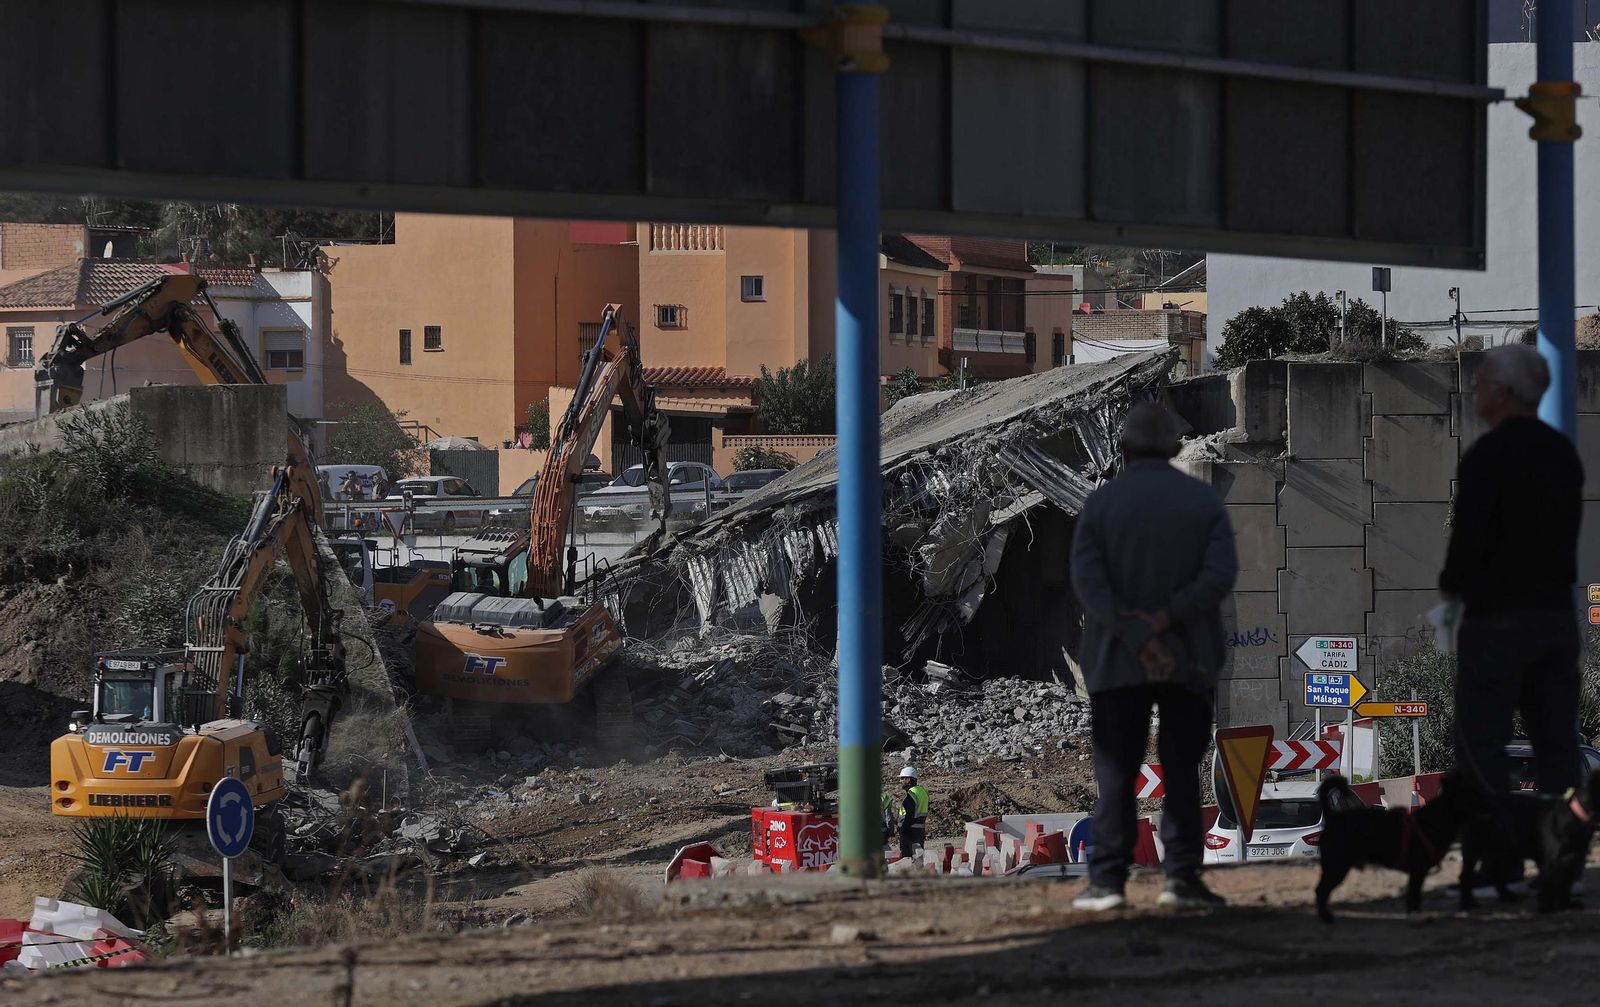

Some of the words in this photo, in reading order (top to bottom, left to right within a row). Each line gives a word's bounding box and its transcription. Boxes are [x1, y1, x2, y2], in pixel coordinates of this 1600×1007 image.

[464, 652, 507, 675] FT
[1321, 658, 1348, 668] CÁDIZ
[442, 674, 529, 687] DEMOLICIONES
[1329, 676, 1342, 684] A-7
[1307, 685, 1322, 694] San
[1324, 685, 1350, 695] Roque
[1313, 695, 1343, 704] Málaga
[89, 732, 171, 745] DEMOLICIONES
[102, 748, 155, 773] FT
[88, 794, 172, 807] LIEBHERR
[770, 820, 786, 831] RINO
[1251, 847, 1270, 856] 9721
[1271, 847, 1286, 856] JDG
